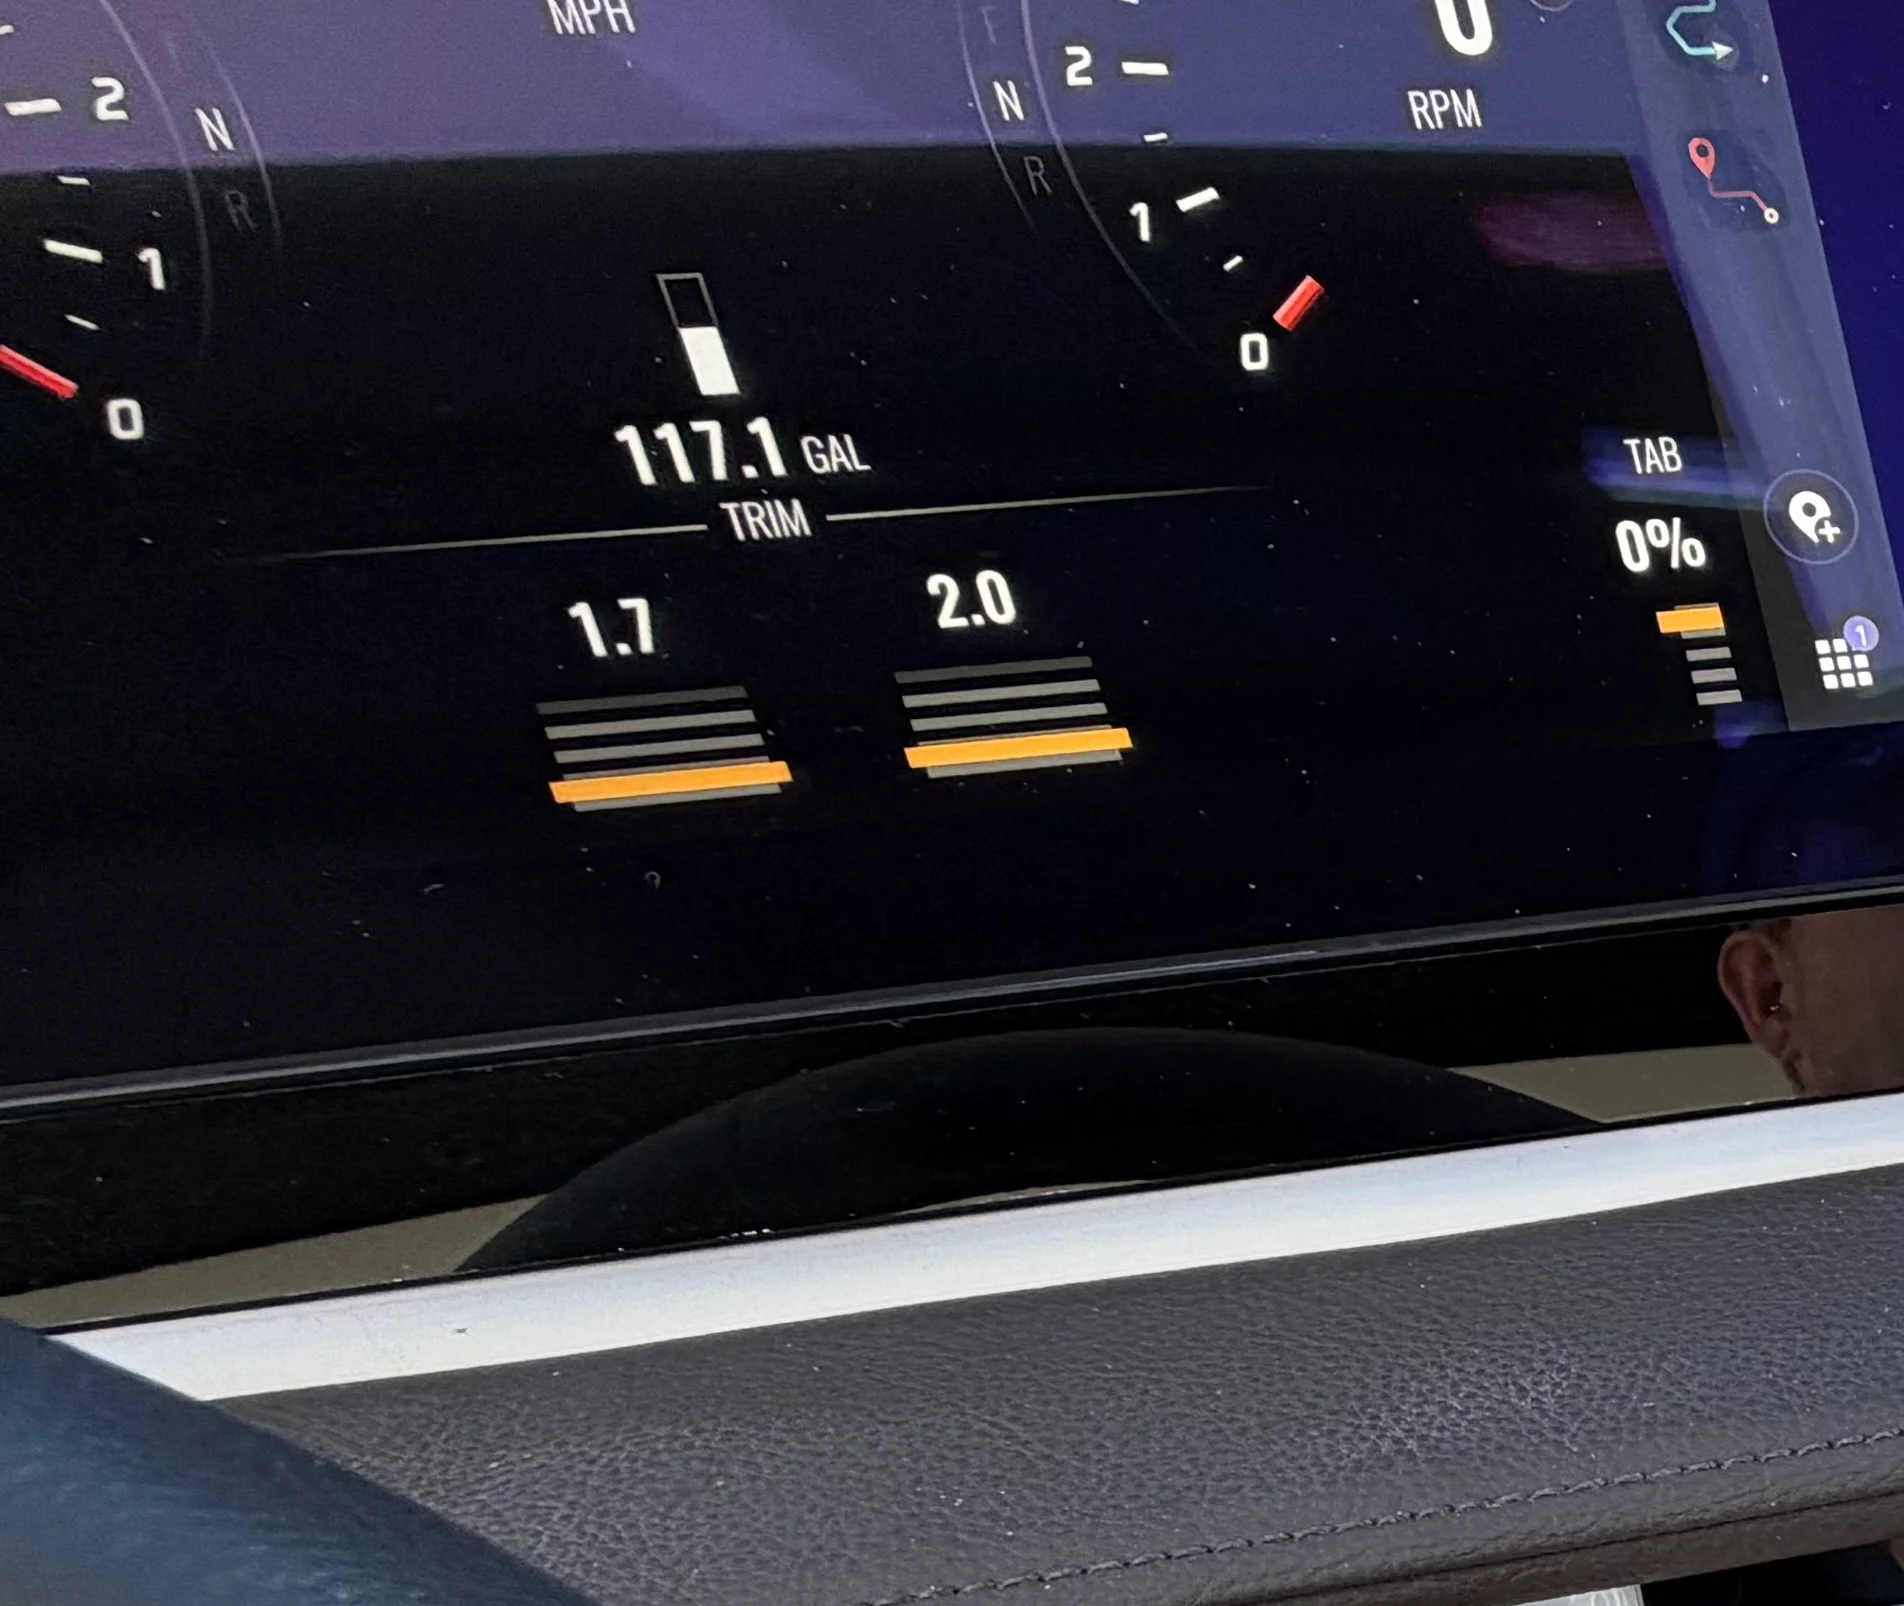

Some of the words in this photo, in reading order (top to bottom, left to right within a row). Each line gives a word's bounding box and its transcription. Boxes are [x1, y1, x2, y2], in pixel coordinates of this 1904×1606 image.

[552, 0, 635, 35] MPH
[1065, 46, 1093, 86] 2
[91, 76, 129, 121] 2
[993, 80, 1025, 121] N
[1407, 89, 1483, 130] RPM
[195, 107, 235, 151] N
[1129, 202, 1151, 242] 1
[138, 247, 165, 290] 1
[1240, 333, 1268, 372] 0
[109, 400, 145, 441] 0
[615, 416, 787, 486] 117.1
[801, 434, 871, 473] GAL
[1624, 437, 1683, 476] TAB
[721, 500, 811, 541] TRIM
[1617, 516, 1707, 575] 0%
[926, 570, 1016, 630] 2.0
[569, 599, 656, 658] 1.7
